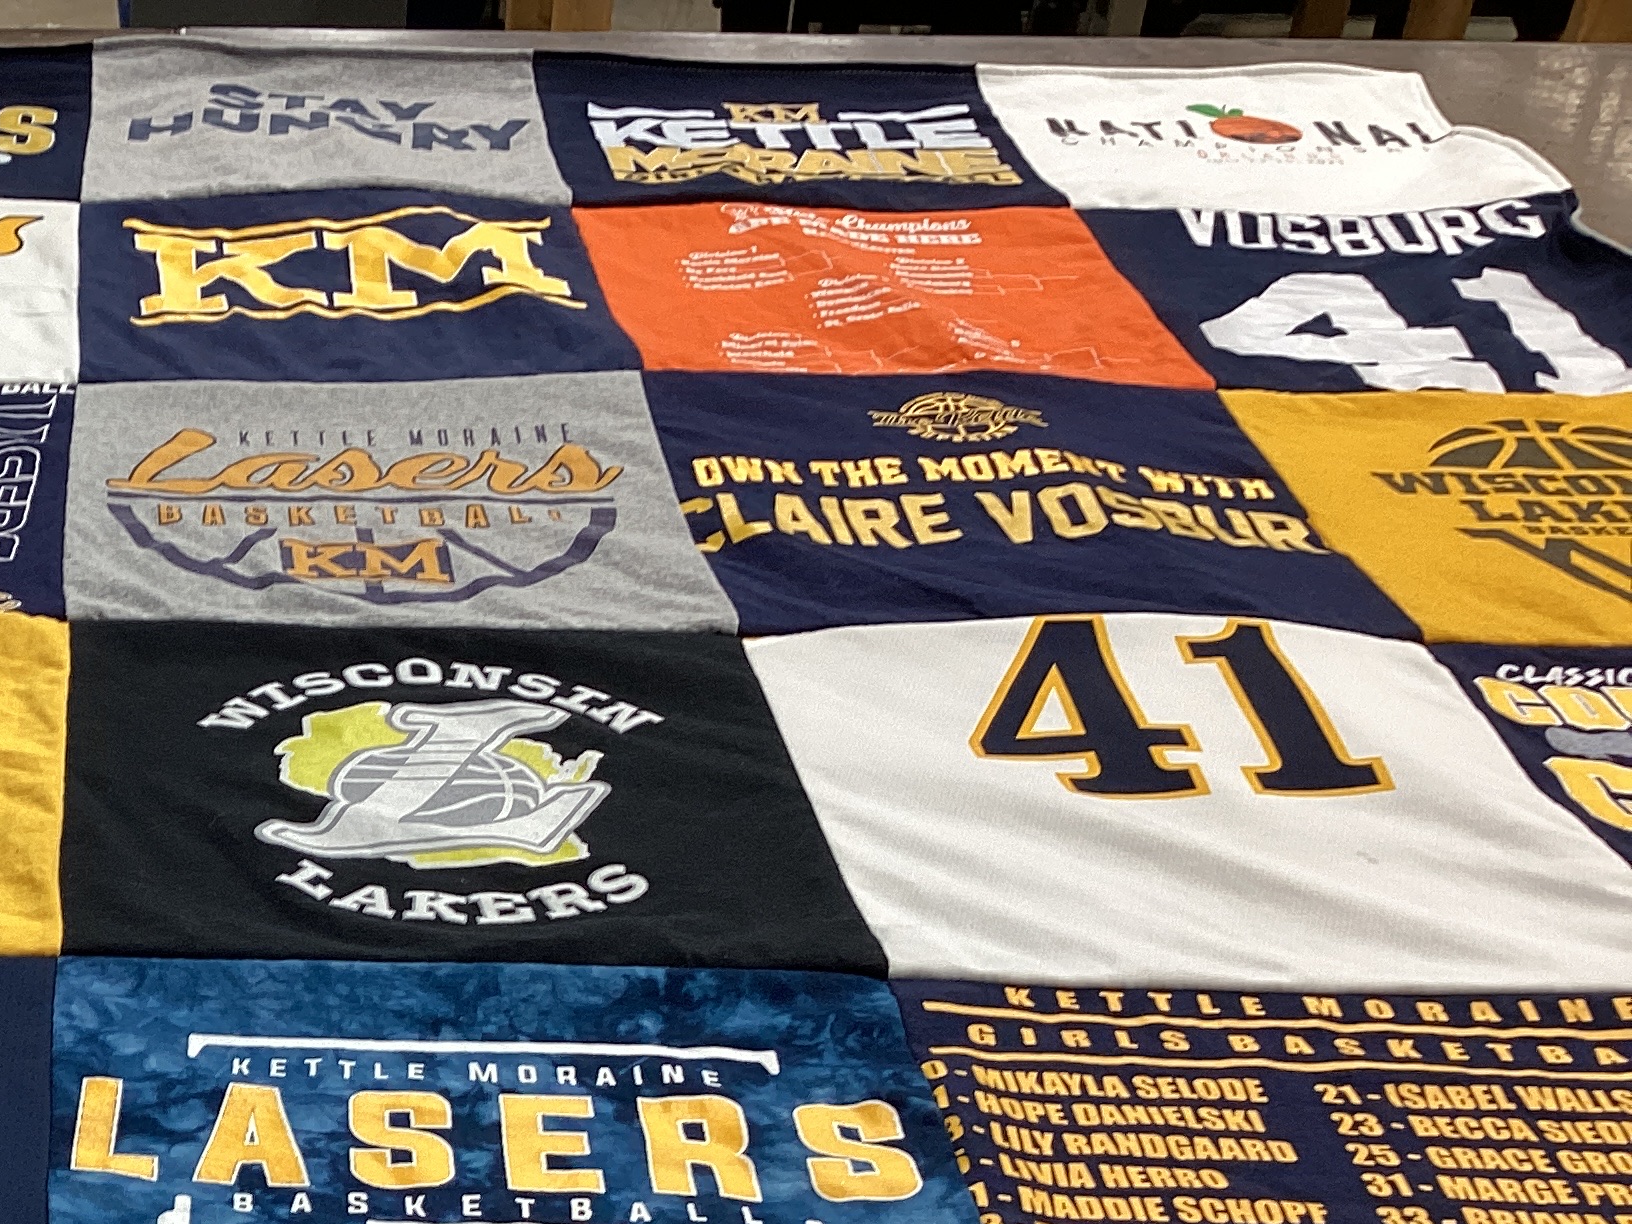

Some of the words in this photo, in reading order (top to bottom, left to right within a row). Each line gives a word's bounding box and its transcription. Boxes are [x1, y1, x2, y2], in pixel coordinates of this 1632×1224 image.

[207, 83, 438, 122] STAY
[588, 117, 993, 150] KETTLE
[1175, 199, 1547, 257] VOSBURG
[132, 220, 574, 317] KM
[1197, 266, 1632, 397] 41
[105, 427, 626, 495] Lasers
[237, 428, 379, 447] KETTLE
[408, 422, 578, 447] MORAINE
[690, 455, 804, 488] OWN
[808, 456, 910, 488] THE
[917, 447, 1130, 483] MOMENT
[1136, 465, 1277, 501] WITH
[677, 490, 966, 554] CLAIRE
[279, 537, 456, 584] KM
[195, 655, 666, 736] WISCONSIN
[968, 613, 1398, 801] 41
[274, 858, 651, 926] LAKERS
[1003, 985, 1267, 1017] KETTLE
[1301, 994, 1632, 1023] MORAINE
[966, 1022, 1192, 1052] GIRLS
[230, 1054, 428, 1083] KETTLE
[469, 1060, 725, 1091] MORAINE
[971, 1063, 1131, 1099] MIKAYLA
[1131, 1074, 1270, 1104] SELODE
[1313, 1083, 1363, 1106] 21
[1382, 1082, 1519, 1112] ISABEL
[70, 1075, 925, 1205] LASERS
[973, 1089, 1070, 1126] HOPE
[1071, 1102, 1267, 1133] DANIELSKI
[1329, 1111, 1386, 1138] 23
[1406, 1113, 1541, 1143] BECCA
[988, 1120, 1055, 1156] LILY
[1060, 1131, 1299, 1164] RANDGAARD
[1344, 1141, 1402, 1167] 25
[1425, 1144, 1559, 1174] GRACE
[998, 1151, 1097, 1190] LIVIA
[1098, 1161, 1231, 1190] HERRO
[1360, 1171, 1414, 1198] 31
[1434, 1173, 1582, 1206] MARGE
[1017, 1185, 1171, 1222] MADDIE
